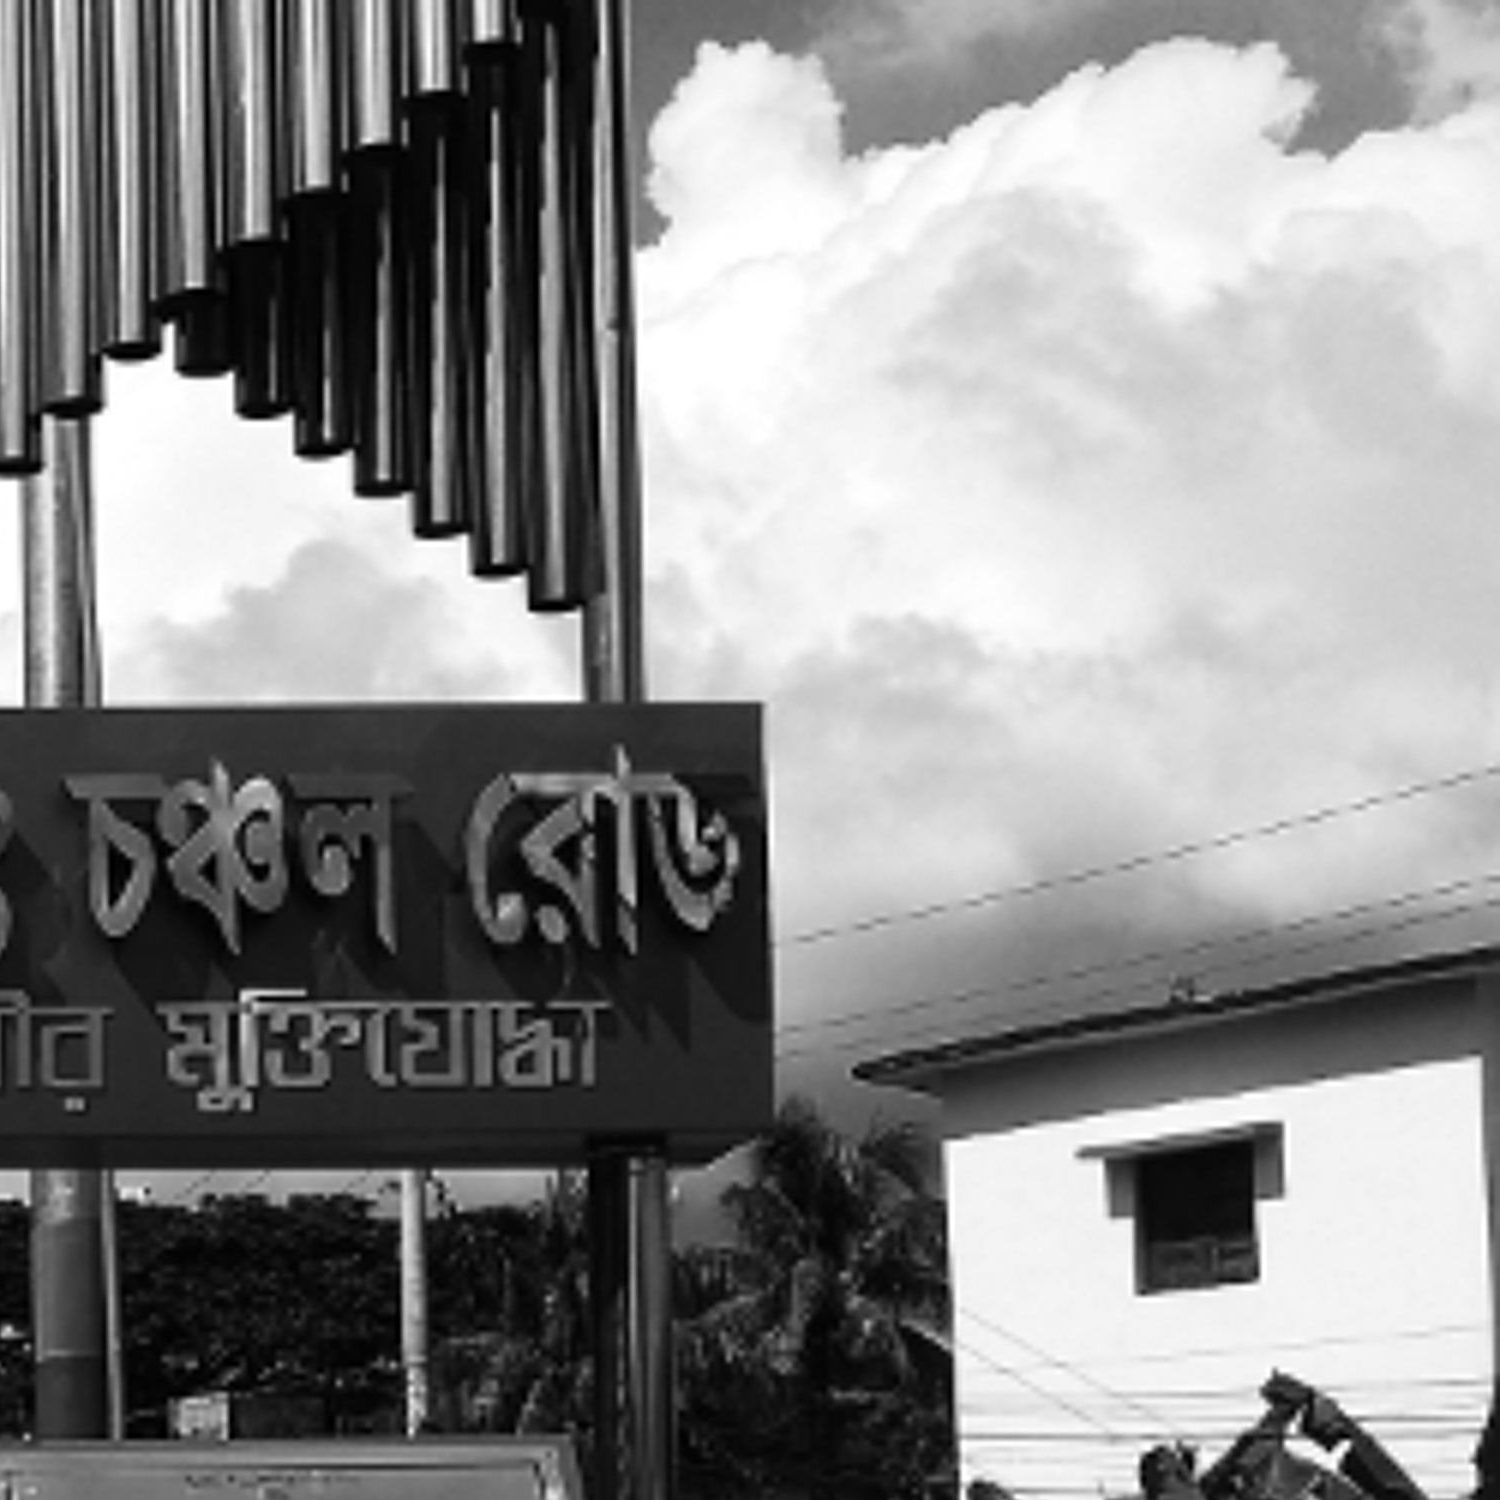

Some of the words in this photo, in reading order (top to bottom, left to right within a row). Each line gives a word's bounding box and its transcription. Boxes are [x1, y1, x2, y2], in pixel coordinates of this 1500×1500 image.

[63, 758, 412, 957] চঞ্চল
[465, 744, 742, 956] রোড
[156, 987, 612, 1112] মুক্তিযোদ্ধা
